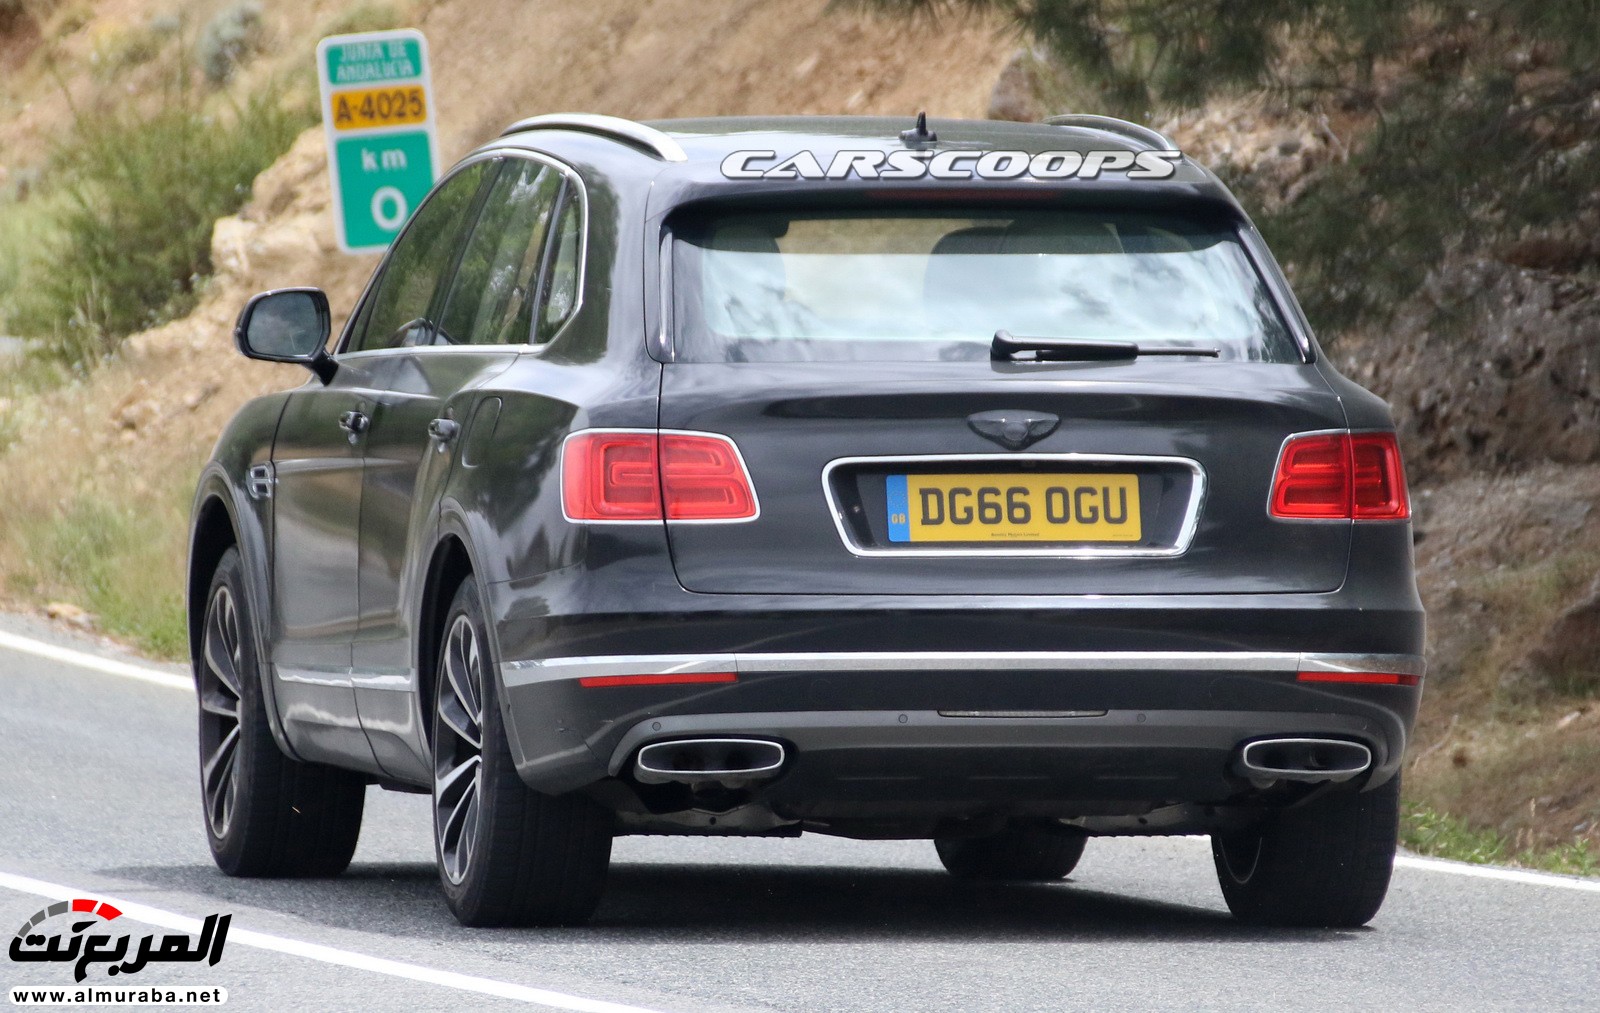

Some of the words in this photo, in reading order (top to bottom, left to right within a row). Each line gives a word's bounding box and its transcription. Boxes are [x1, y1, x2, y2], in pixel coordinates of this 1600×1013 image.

[388, 39, 406, 58] DE
[336, 89, 424, 124] A-4025
[361, 147, 408, 172] km
[370, 185, 408, 232] 0
[919, 486, 1032, 526] DG66
[1045, 486, 1129, 525] OGU
